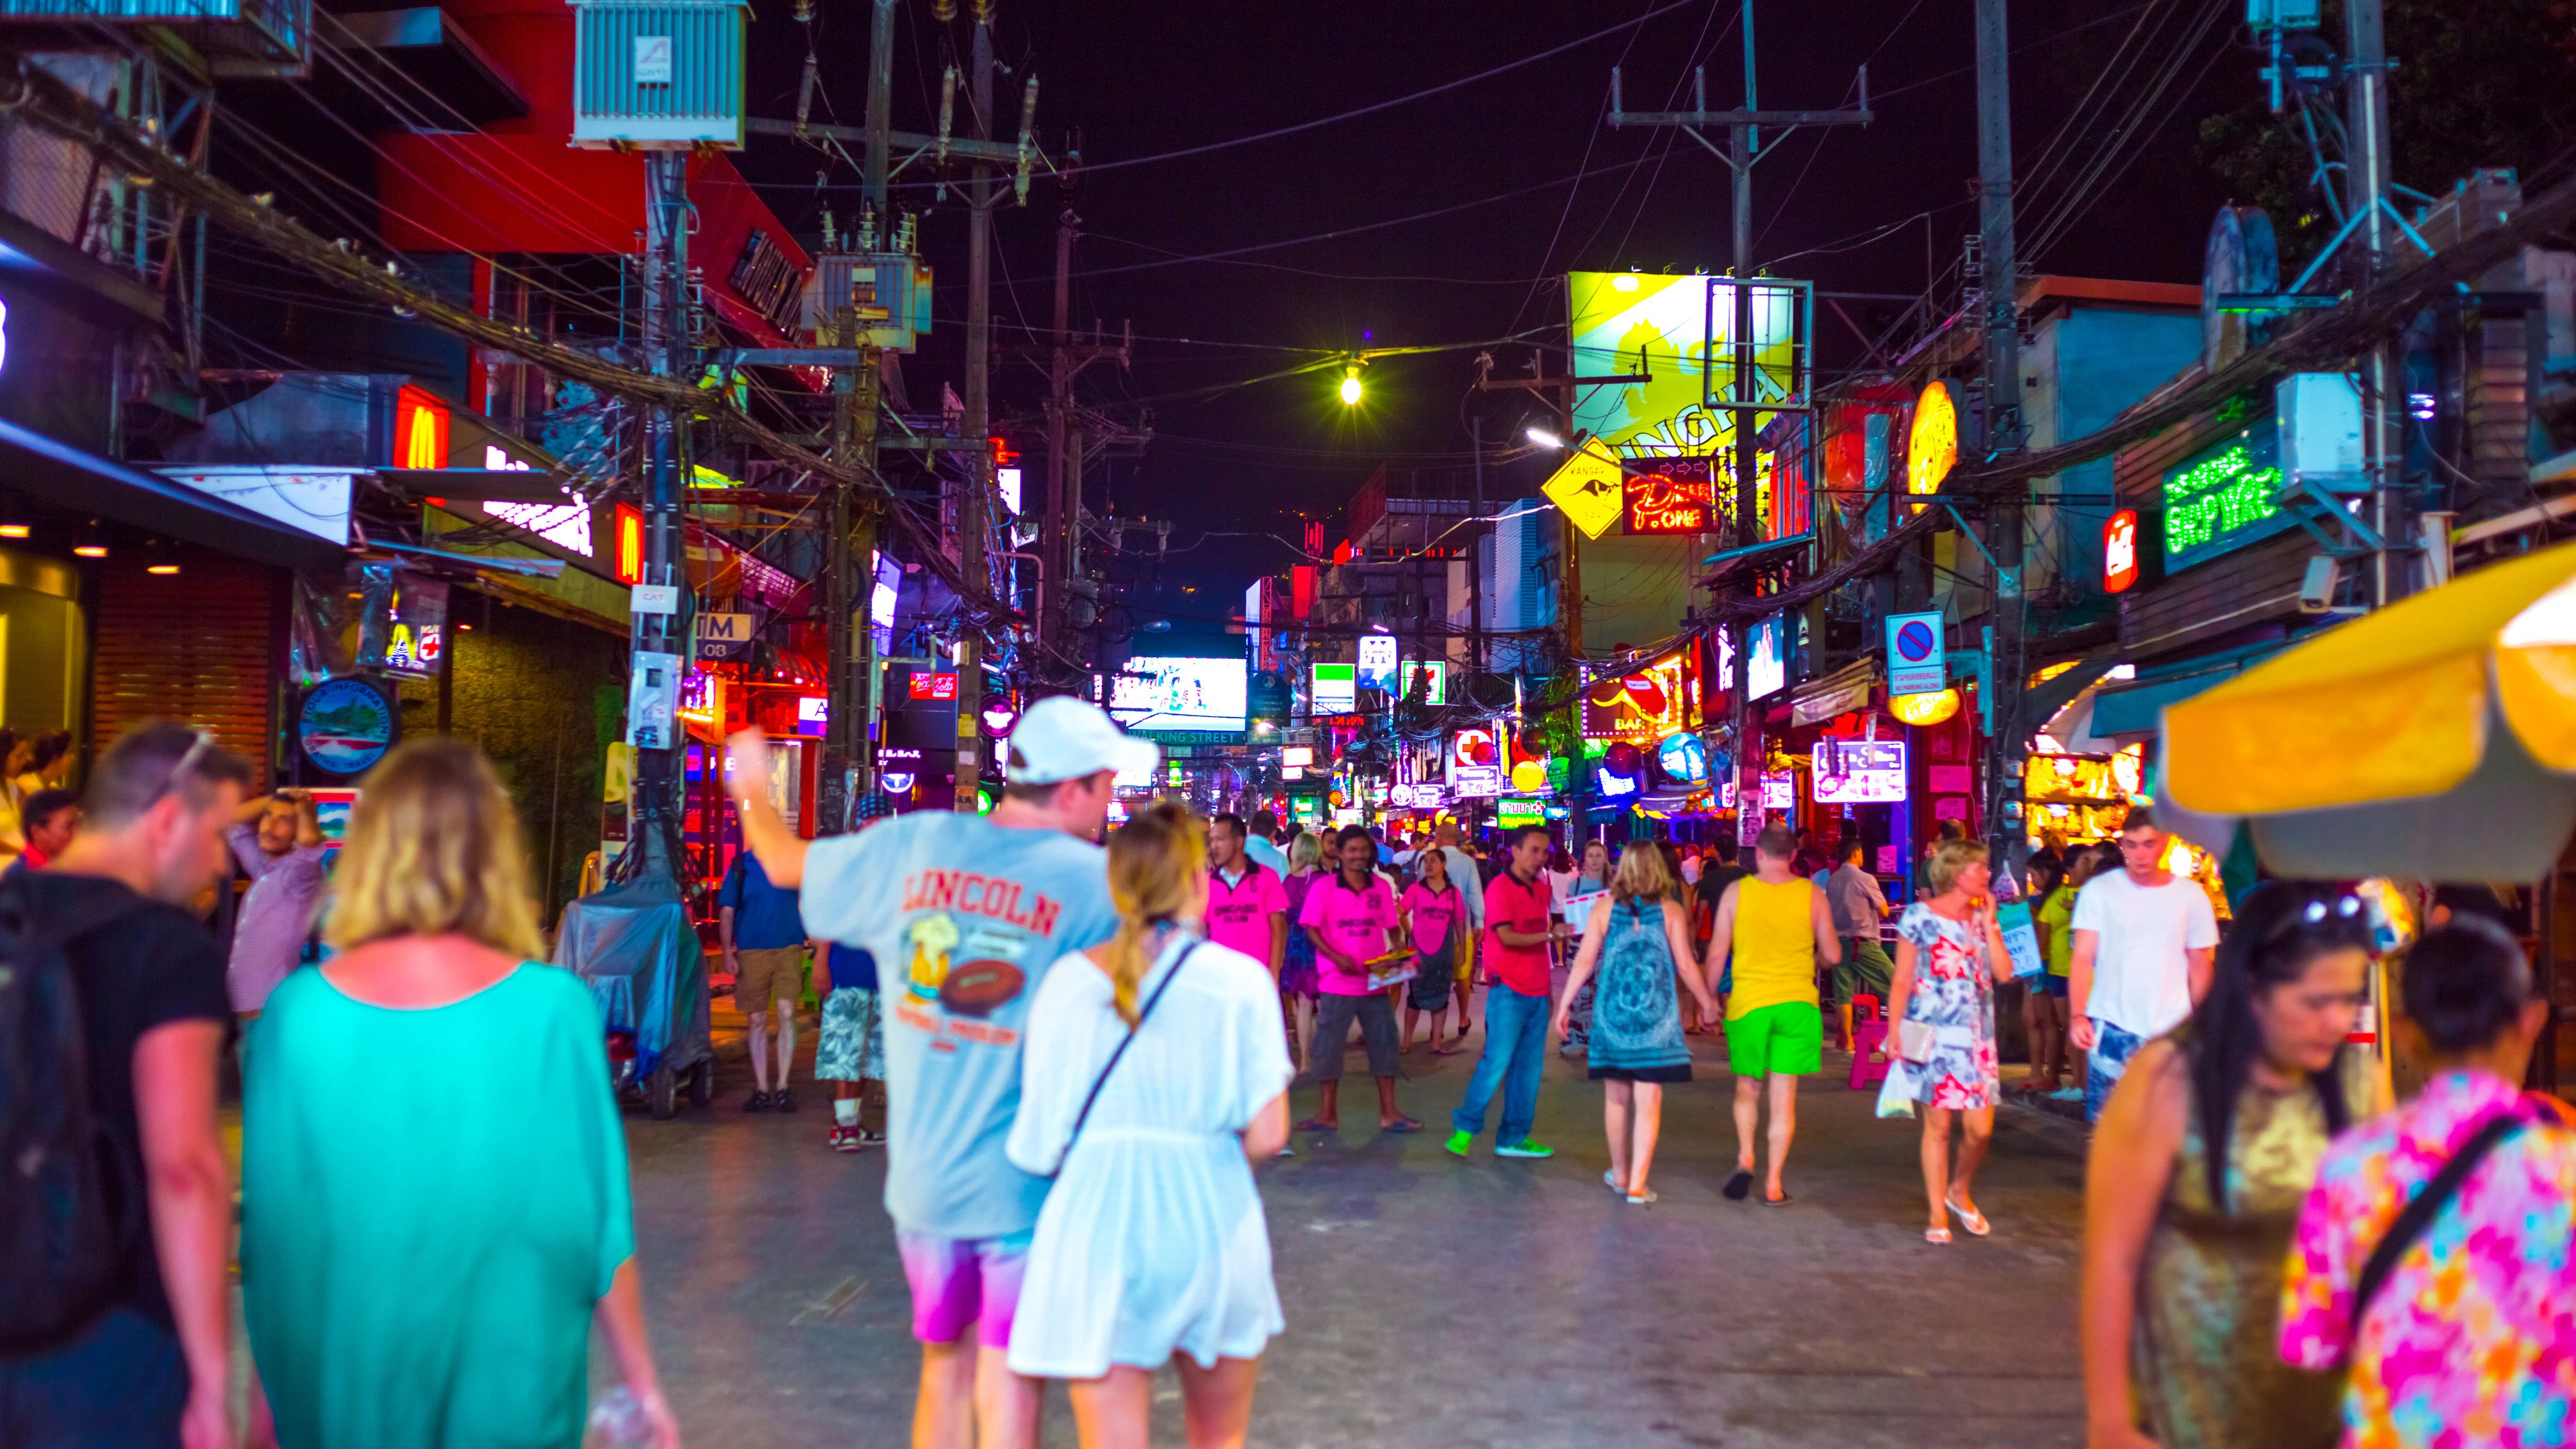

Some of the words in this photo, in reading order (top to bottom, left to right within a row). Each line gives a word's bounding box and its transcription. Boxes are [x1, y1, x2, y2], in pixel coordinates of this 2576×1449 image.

[643, 593, 665, 601] CAT
[1190, 731, 1234, 743] STREET
[901, 868, 1061, 938] LINCOLN
